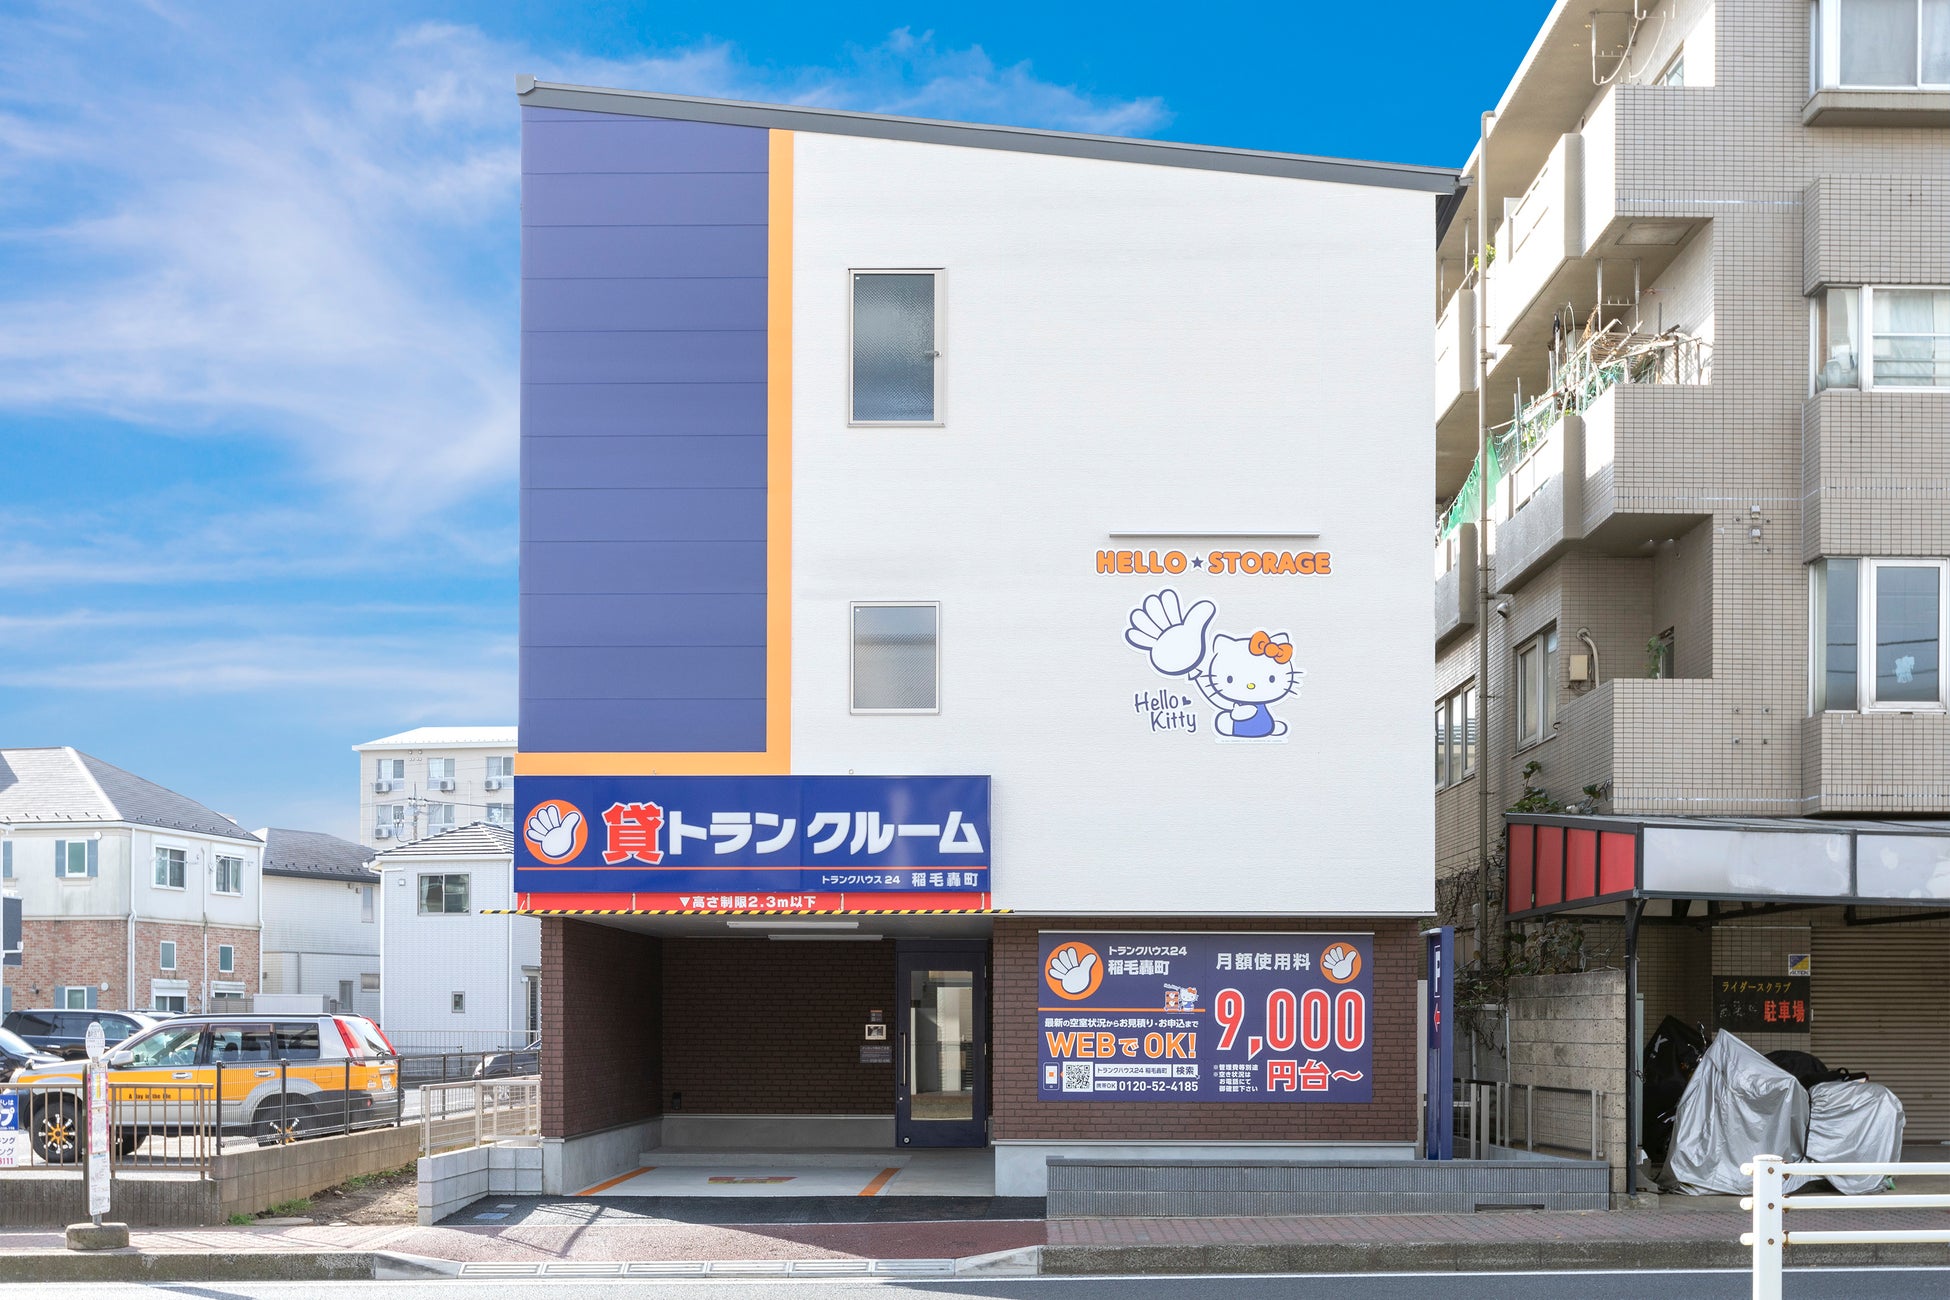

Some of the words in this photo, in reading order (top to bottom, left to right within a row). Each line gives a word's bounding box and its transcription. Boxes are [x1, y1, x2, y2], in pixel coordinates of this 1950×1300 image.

[1096, 550, 1187, 574] HELLO
[1208, 551, 1331, 574] STORAGE
[1134, 690, 1179, 713] Hello
[1150, 711, 1196, 733] Kitty
[601, 801, 984, 865] 貸トランクルーム
[911, 872, 979, 887] 稲毛轟町
[1108, 946, 1188, 956] トランクハウス24
[1108, 960, 1170, 975] 稲毛轟町
[1216, 953, 1311, 971] 月額使用料
[1763, 1000, 1805, 1022] 駐車場
[1044, 1018, 1198, 1028] 最新の空室状況からお見積り・お申込まで
[1215, 988, 1365, 1061] 9,000
[1176, 1066, 1195, 1075] 検索
[1118, 1081, 1199, 1092] 0120-52-4185
